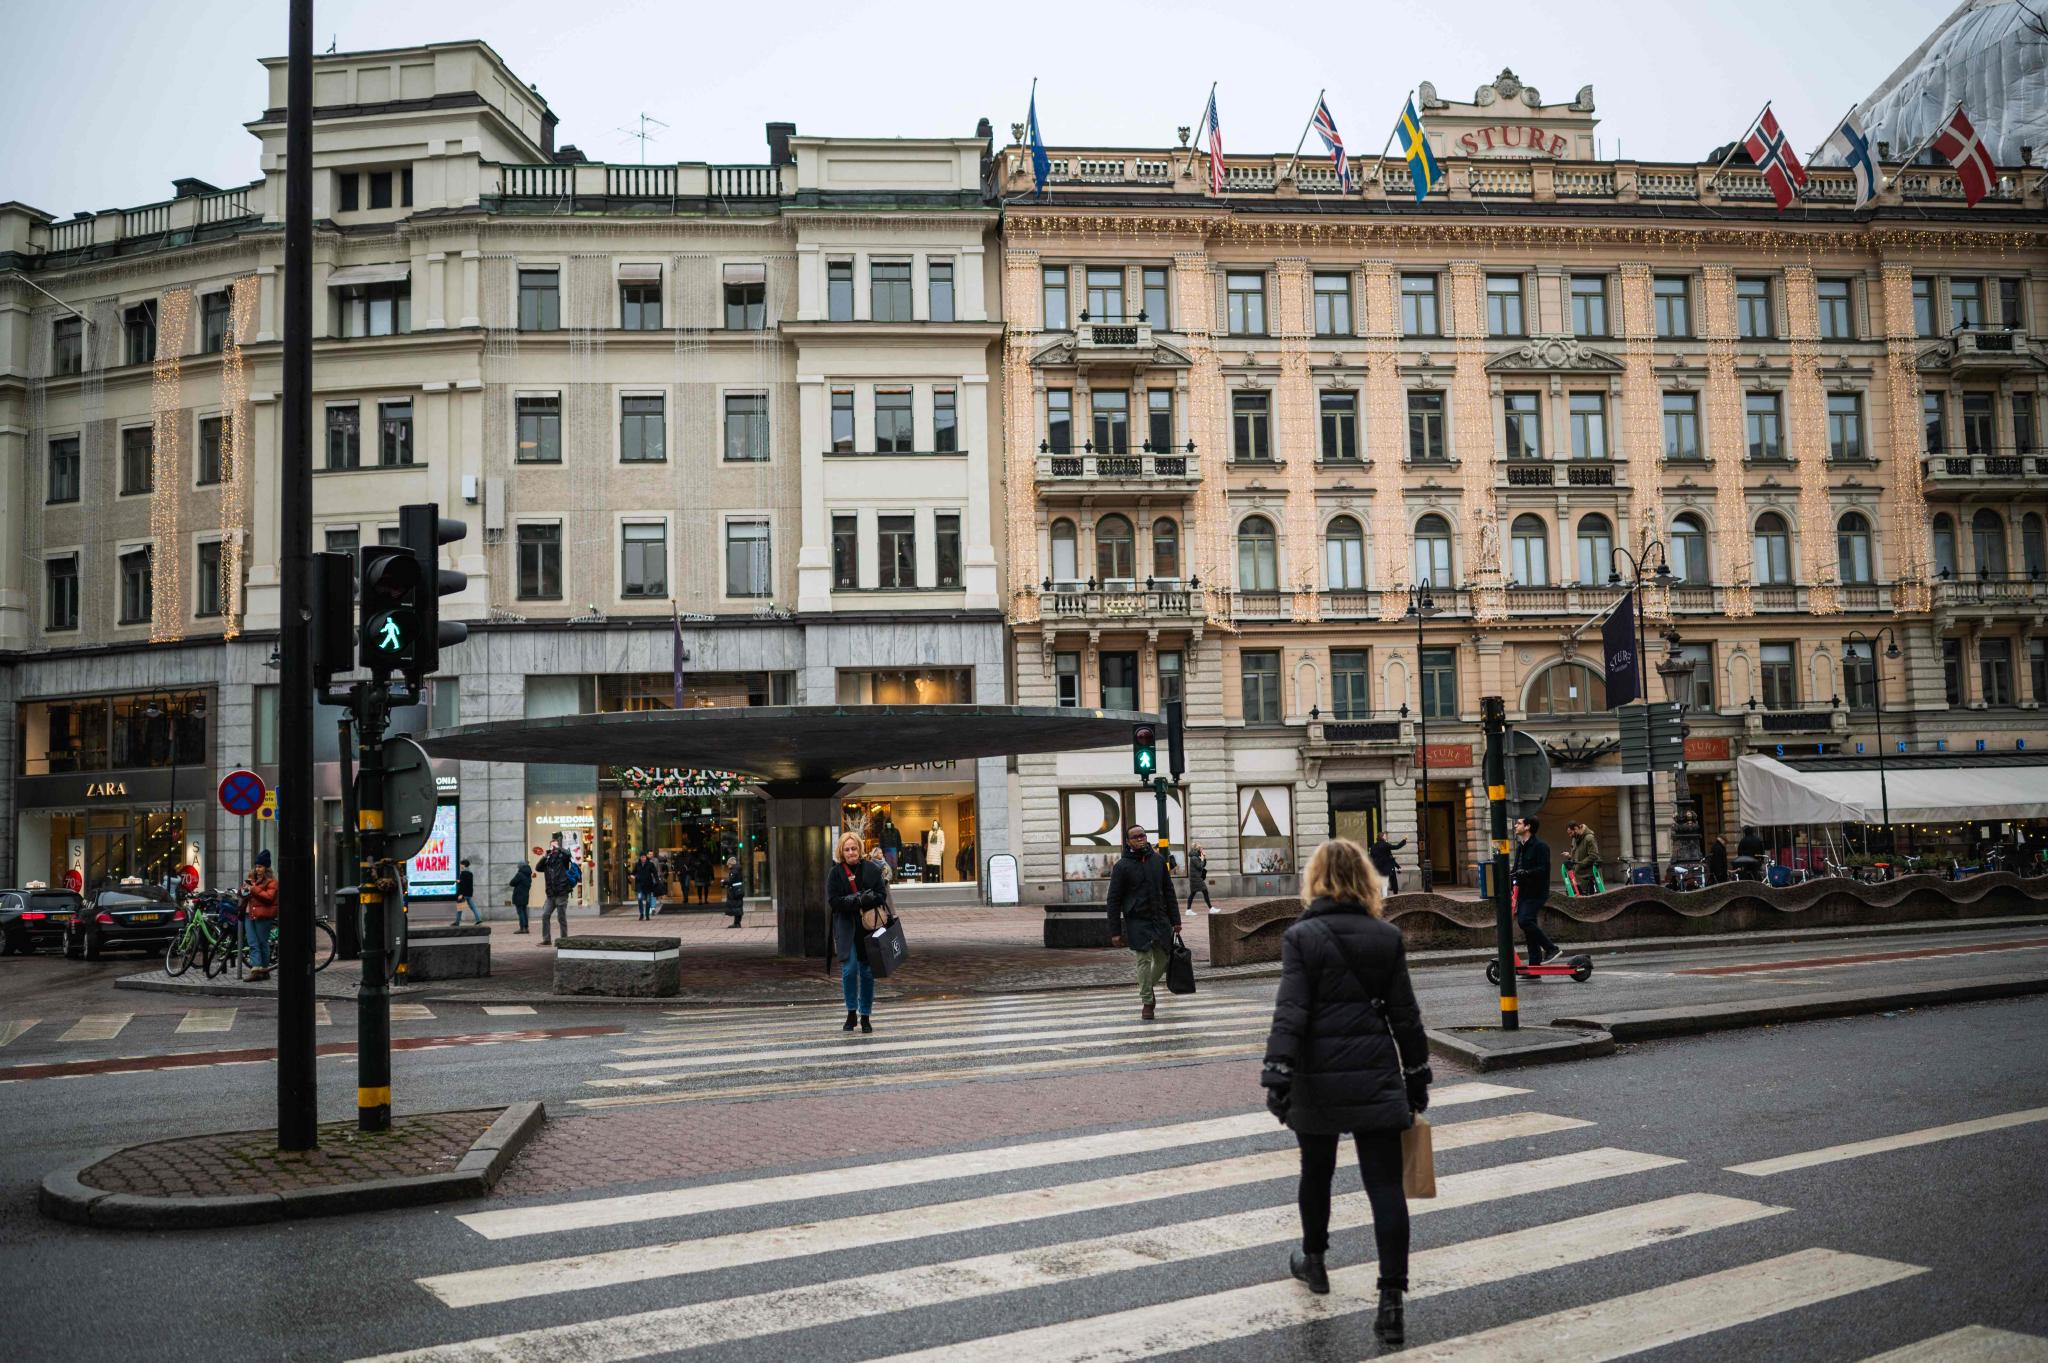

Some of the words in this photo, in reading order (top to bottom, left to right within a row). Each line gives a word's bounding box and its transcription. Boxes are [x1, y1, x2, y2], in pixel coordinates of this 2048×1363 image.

[1461, 125, 1568, 159] STURE
[86, 782, 128, 797] ZARA
[535, 815, 595, 825] CALZEDONIA
[415, 856, 450, 872] WARM!
